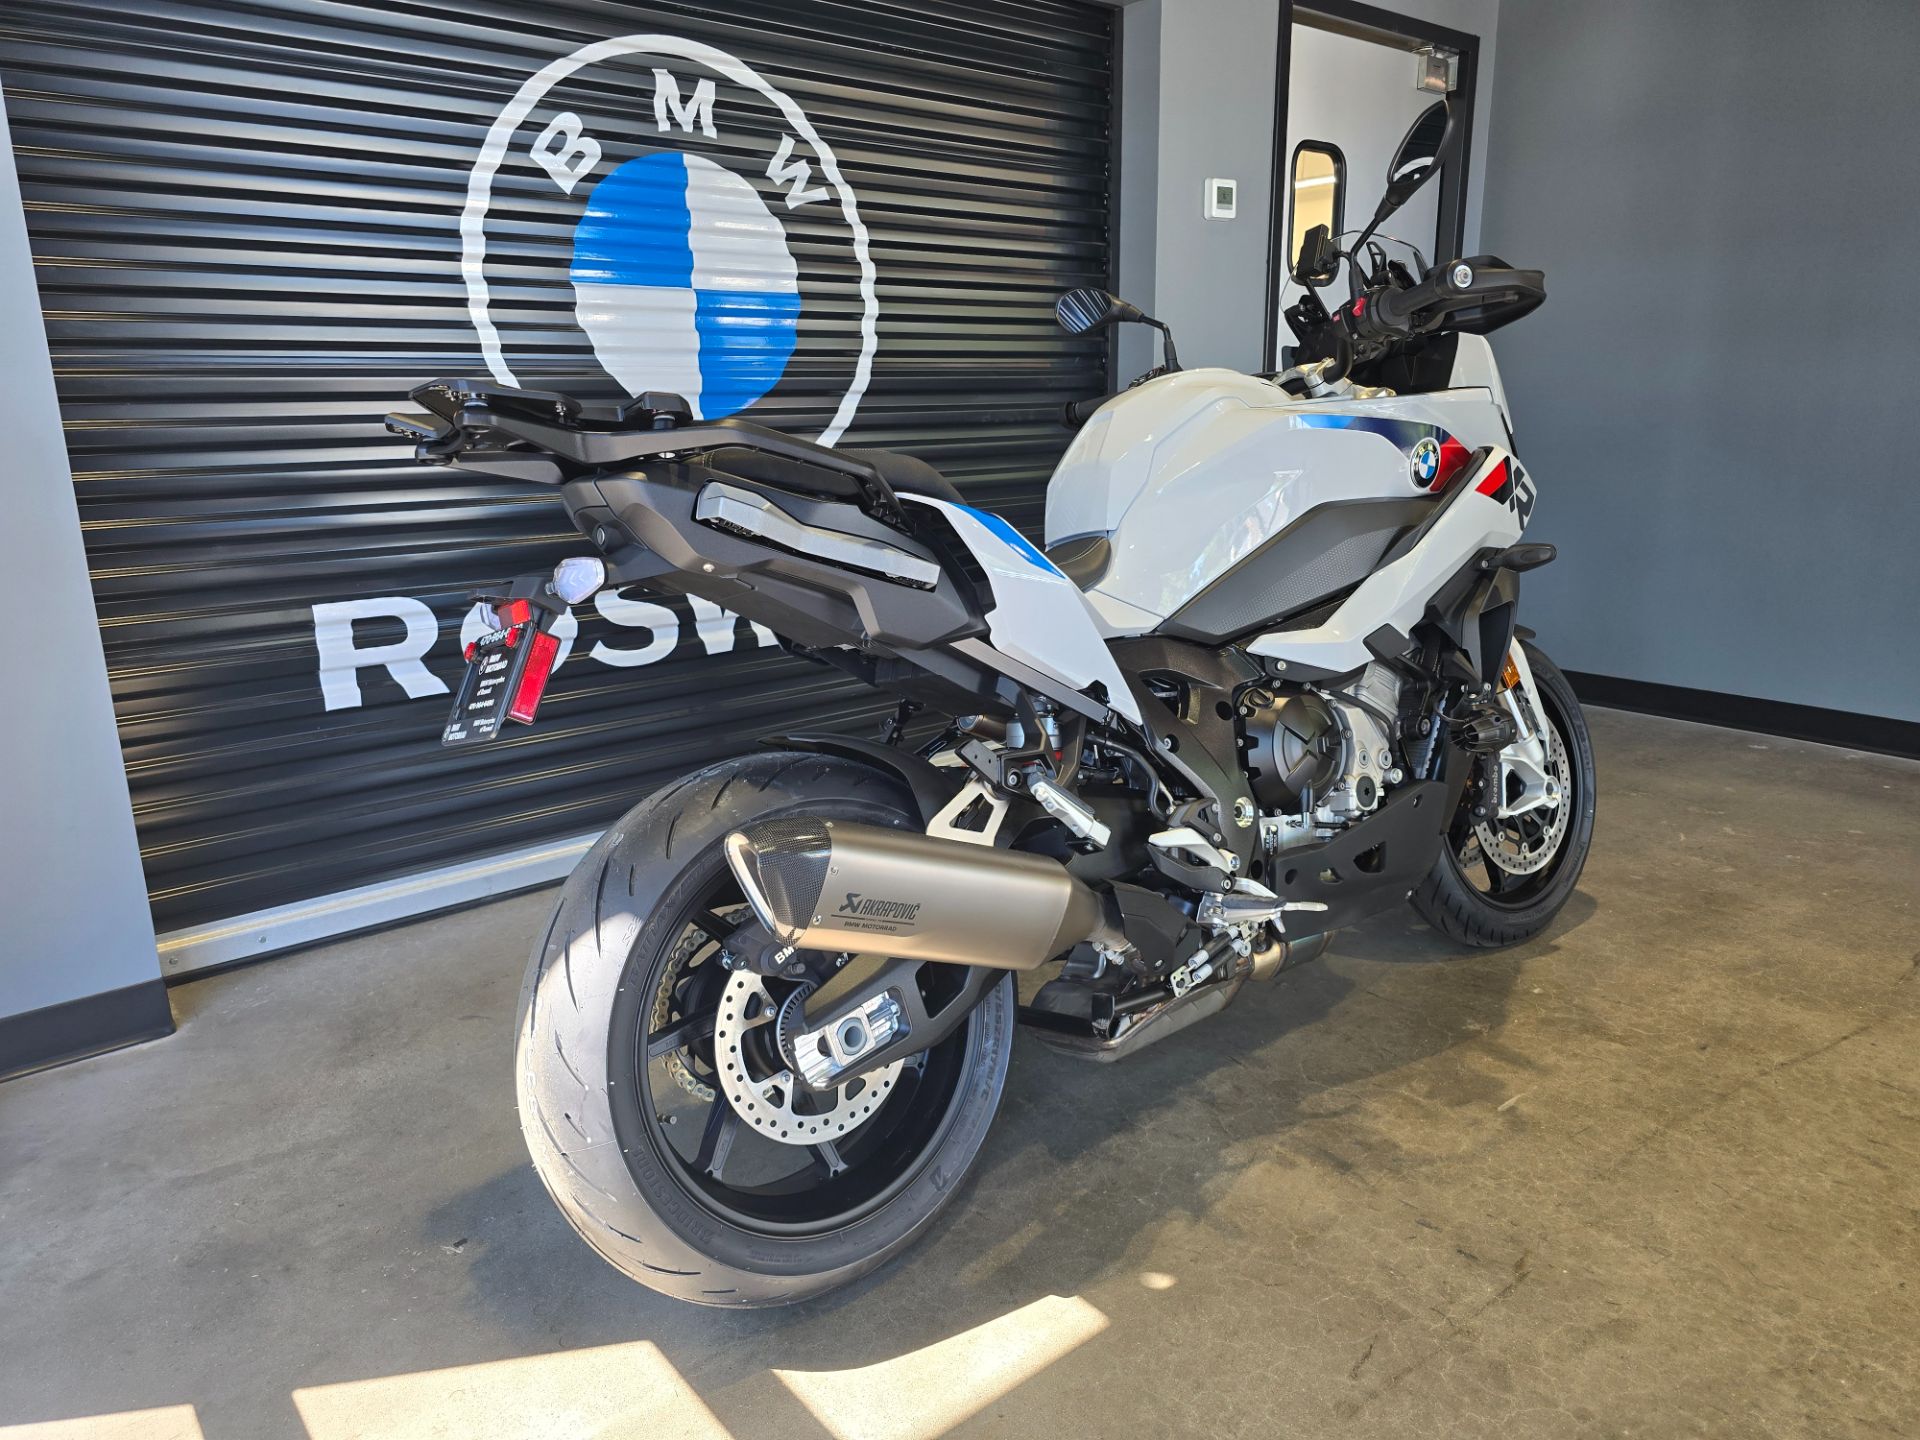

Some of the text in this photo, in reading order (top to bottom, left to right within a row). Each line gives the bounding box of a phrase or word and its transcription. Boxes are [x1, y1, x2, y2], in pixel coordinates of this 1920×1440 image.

[529, 68, 830, 210] BMW
[1491, 765, 1499, 803] brembo
[861, 923, 897, 932] MOTORRAD
[774, 946, 796, 965] BM
